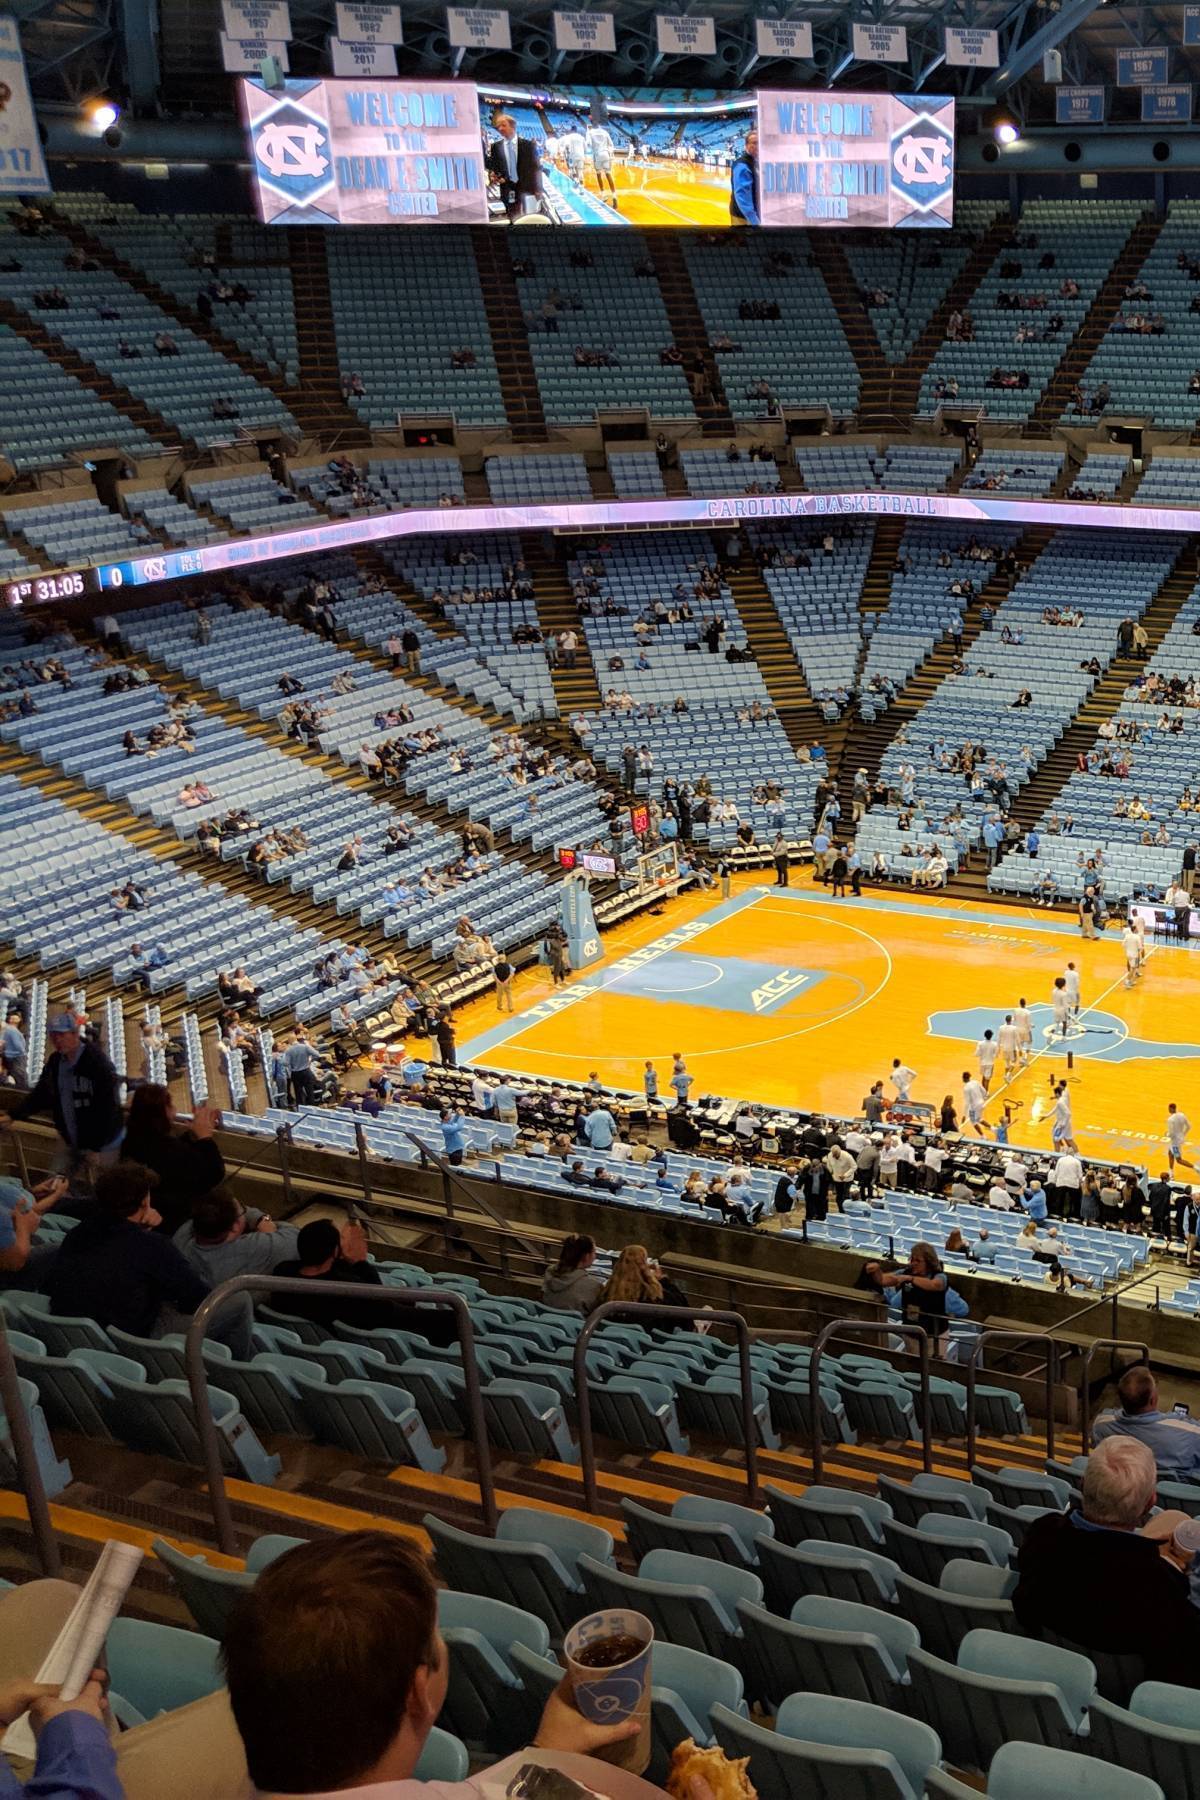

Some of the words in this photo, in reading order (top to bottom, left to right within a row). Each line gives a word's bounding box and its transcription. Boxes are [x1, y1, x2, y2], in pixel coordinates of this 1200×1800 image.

[345, 92, 460, 128] WELCOME
[777, 101, 873, 136] WELCOME
[384, 133, 401, 151] TO
[405, 132, 427, 151] THE
[807, 140, 821, 158] TO
[824, 140, 843, 158] THE
[339, 156, 391, 190] DEAN
[416, 157, 479, 191] SMITH
[764, 161, 809, 193] DEAN
[831, 163, 886, 195] SMITH
[388, 192, 439, 216] CENTER
[806, 196, 849, 218] CENTER
[708, 498, 807, 517] CAROLINA
[815, 496, 936, 514] BASKETBALL
[38, 575, 84, 600] 31:05
[111, 568, 123, 587] 0
[519, 982, 598, 1019] TAR
[609, 921, 711, 972] HEELS
[752, 970, 806, 1007] ACC
